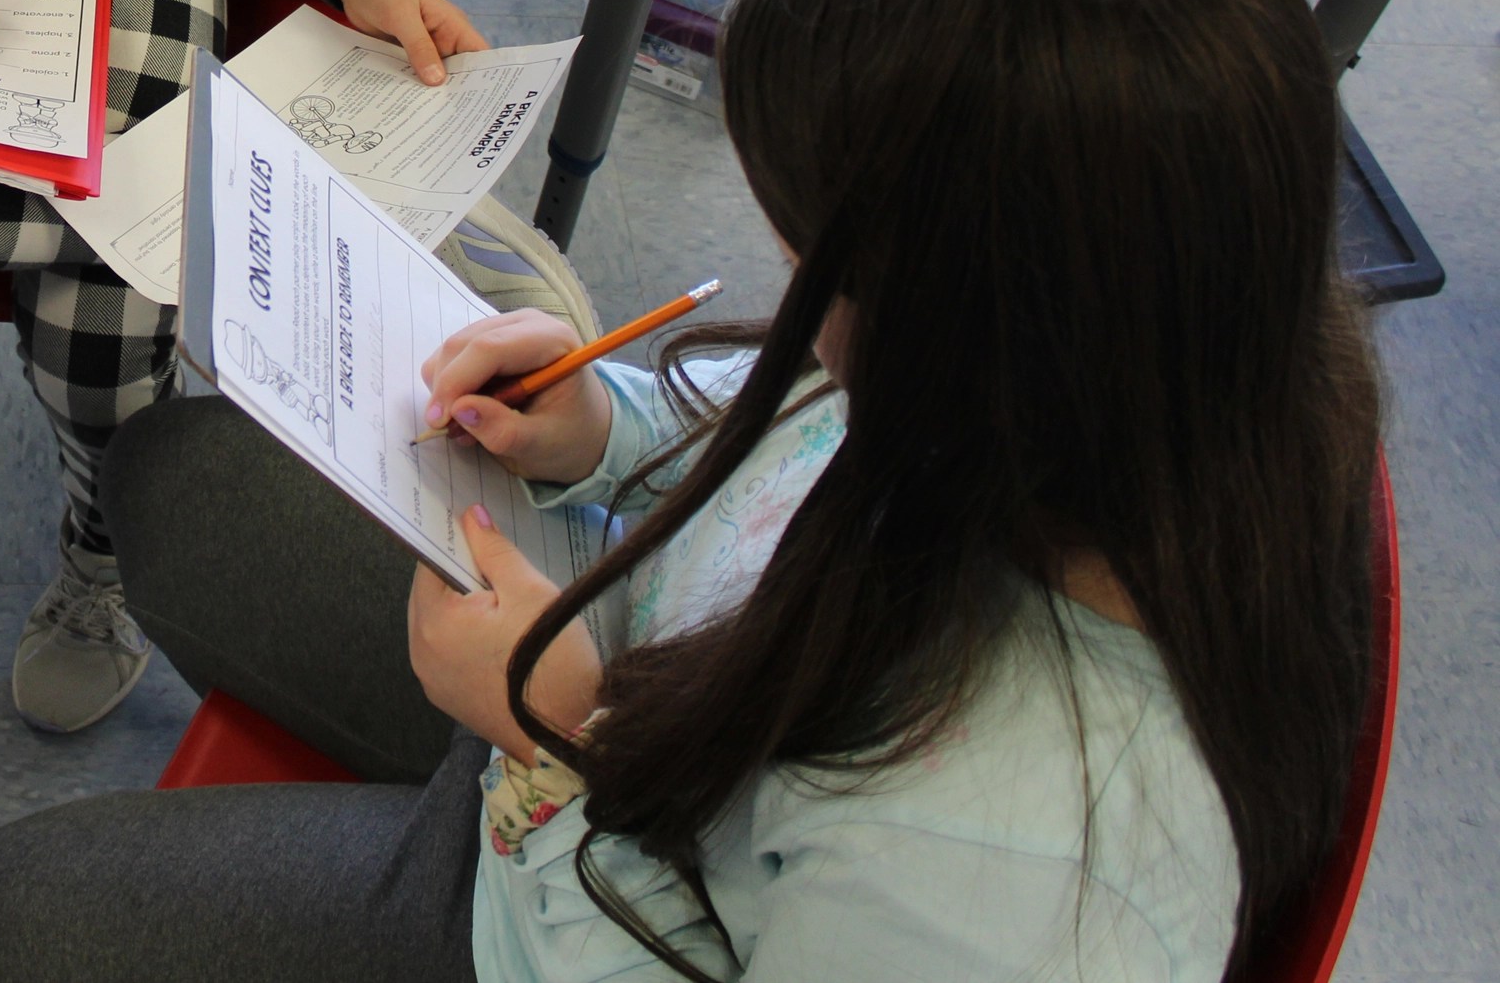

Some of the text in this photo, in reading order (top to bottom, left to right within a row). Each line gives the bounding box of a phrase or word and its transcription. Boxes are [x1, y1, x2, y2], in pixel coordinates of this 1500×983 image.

[22, 66, 59, 76] cajoled
[468, 103, 516, 157] REMEMBER
[505, 102, 532, 127] BIKE
[487, 130, 513, 153] RIDE
[249, 147, 271, 313] CONTEXT CLUES
[336, 234, 352, 411] A BIKE RIDE TO REMEMBER
